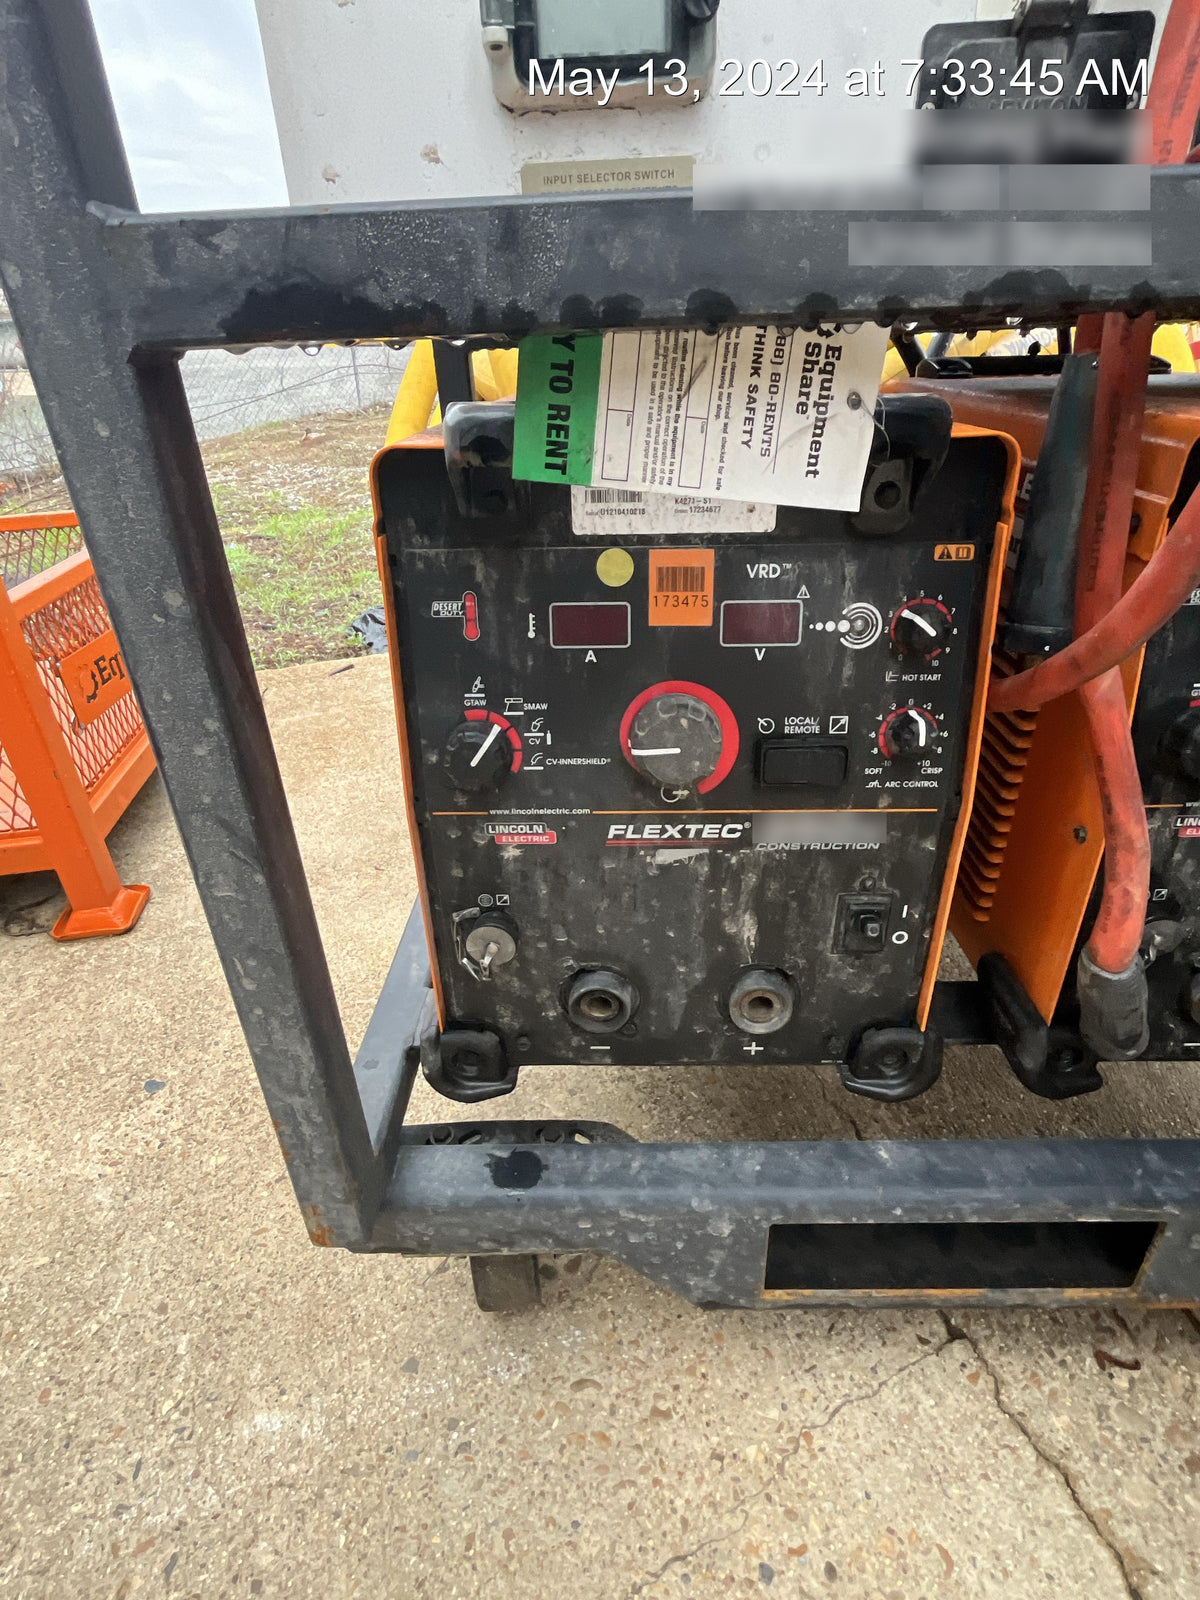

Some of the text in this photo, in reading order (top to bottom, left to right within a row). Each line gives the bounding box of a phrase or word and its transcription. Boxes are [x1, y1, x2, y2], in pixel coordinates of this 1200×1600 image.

[543, 169, 675, 185] INPUT SELECTOR SWITCH
[723, 342, 731, 363] before
[550, 359, 574, 394] TO
[669, 357, 678, 392] instructions
[677, 364, 686, 391] cleaning
[719, 366, 728, 389] leaving
[742, 326, 767, 450] THINK SAFETY
[724, 392, 732, 419] serviced
[760, 372, 781, 457] 80-RENTS
[805, 344, 842, 478] Equipment
[545, 403, 571, 475] RENT
[670, 426, 678, 459] equipment
[667, 477, 673, 486] my
[434, 602, 462, 611] DESERT
[654, 594, 708, 607] 173475
[585, 650, 597, 662] A
[754, 648, 766, 661] V
[784, 725, 820, 734] REMOTE
[488, 824, 544, 834] LINCOLN
